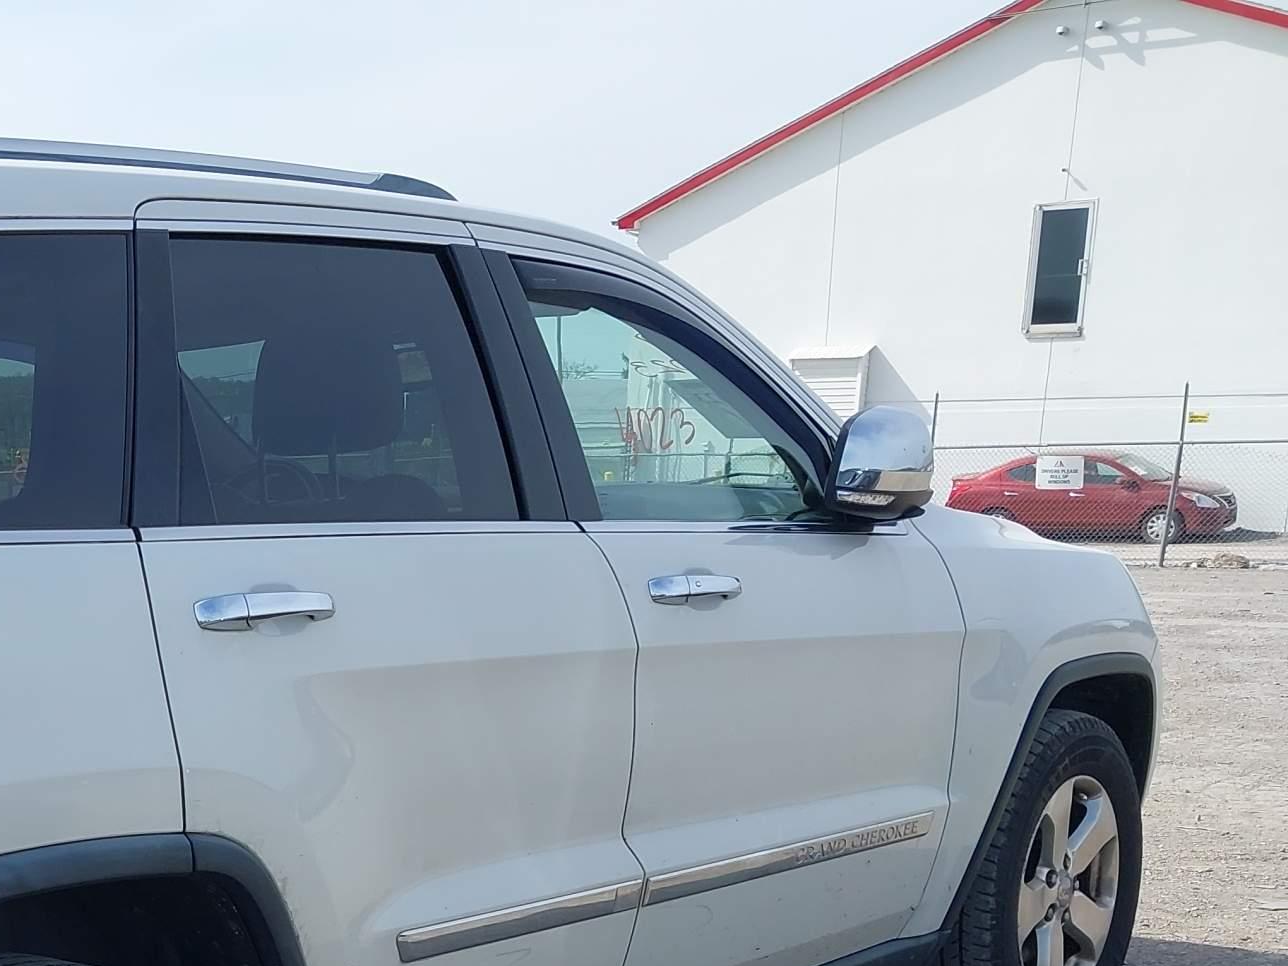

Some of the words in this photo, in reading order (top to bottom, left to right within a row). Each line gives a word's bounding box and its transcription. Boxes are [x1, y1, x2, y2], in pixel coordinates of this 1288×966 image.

[614, 406, 696, 450] 4023
[794, 837, 847, 865] GRAND
[851, 820, 919, 849] CHEROKEE
